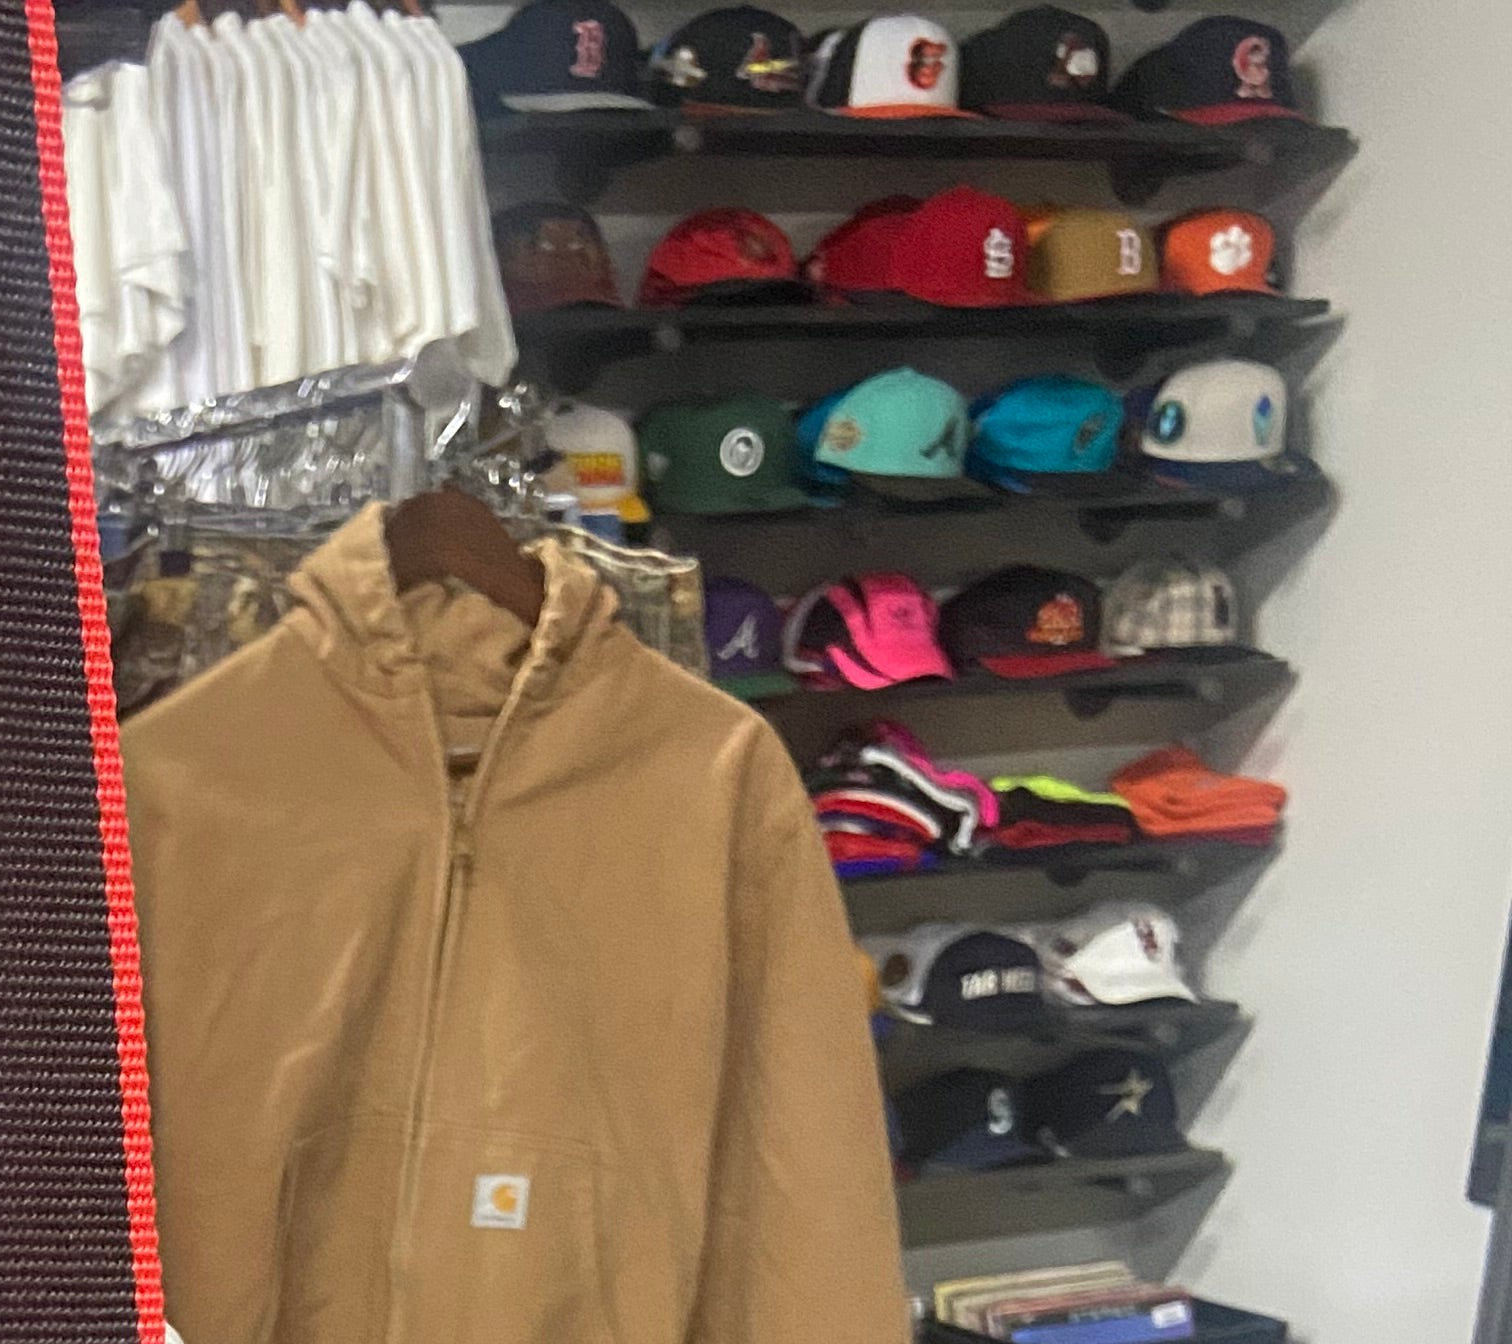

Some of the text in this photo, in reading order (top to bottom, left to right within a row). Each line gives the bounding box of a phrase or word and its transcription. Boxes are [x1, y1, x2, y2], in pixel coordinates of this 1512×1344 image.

[1116, 228, 1142, 275] B
[717, 614, 759, 660] A
[989, 1088, 1014, 1135] S
